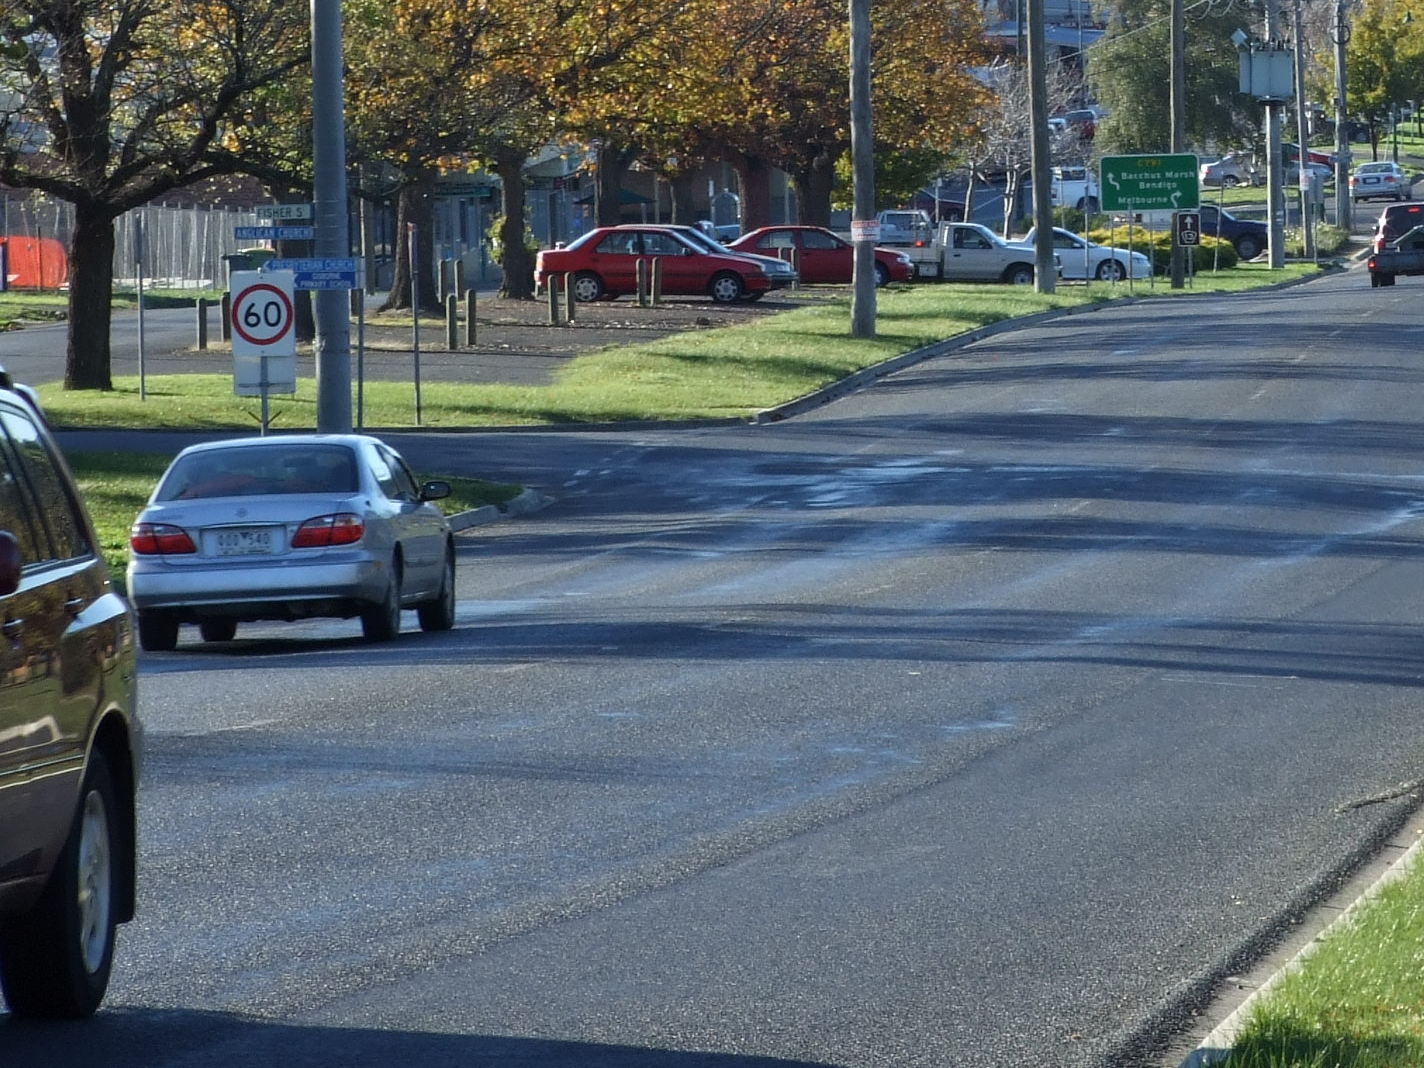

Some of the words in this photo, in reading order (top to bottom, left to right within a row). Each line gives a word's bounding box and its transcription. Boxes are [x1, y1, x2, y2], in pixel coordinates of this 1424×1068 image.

[1121, 172, 1161, 180] Bacchus
[1165, 171, 1195, 179] Marsh
[1139, 181, 1177, 190] Bendigo
[1118, 196, 1168, 204] Melbourne
[257, 208, 291, 218] FISHER
[325, 259, 353, 270] CHURCH
[244, 301, 281, 327] 60
